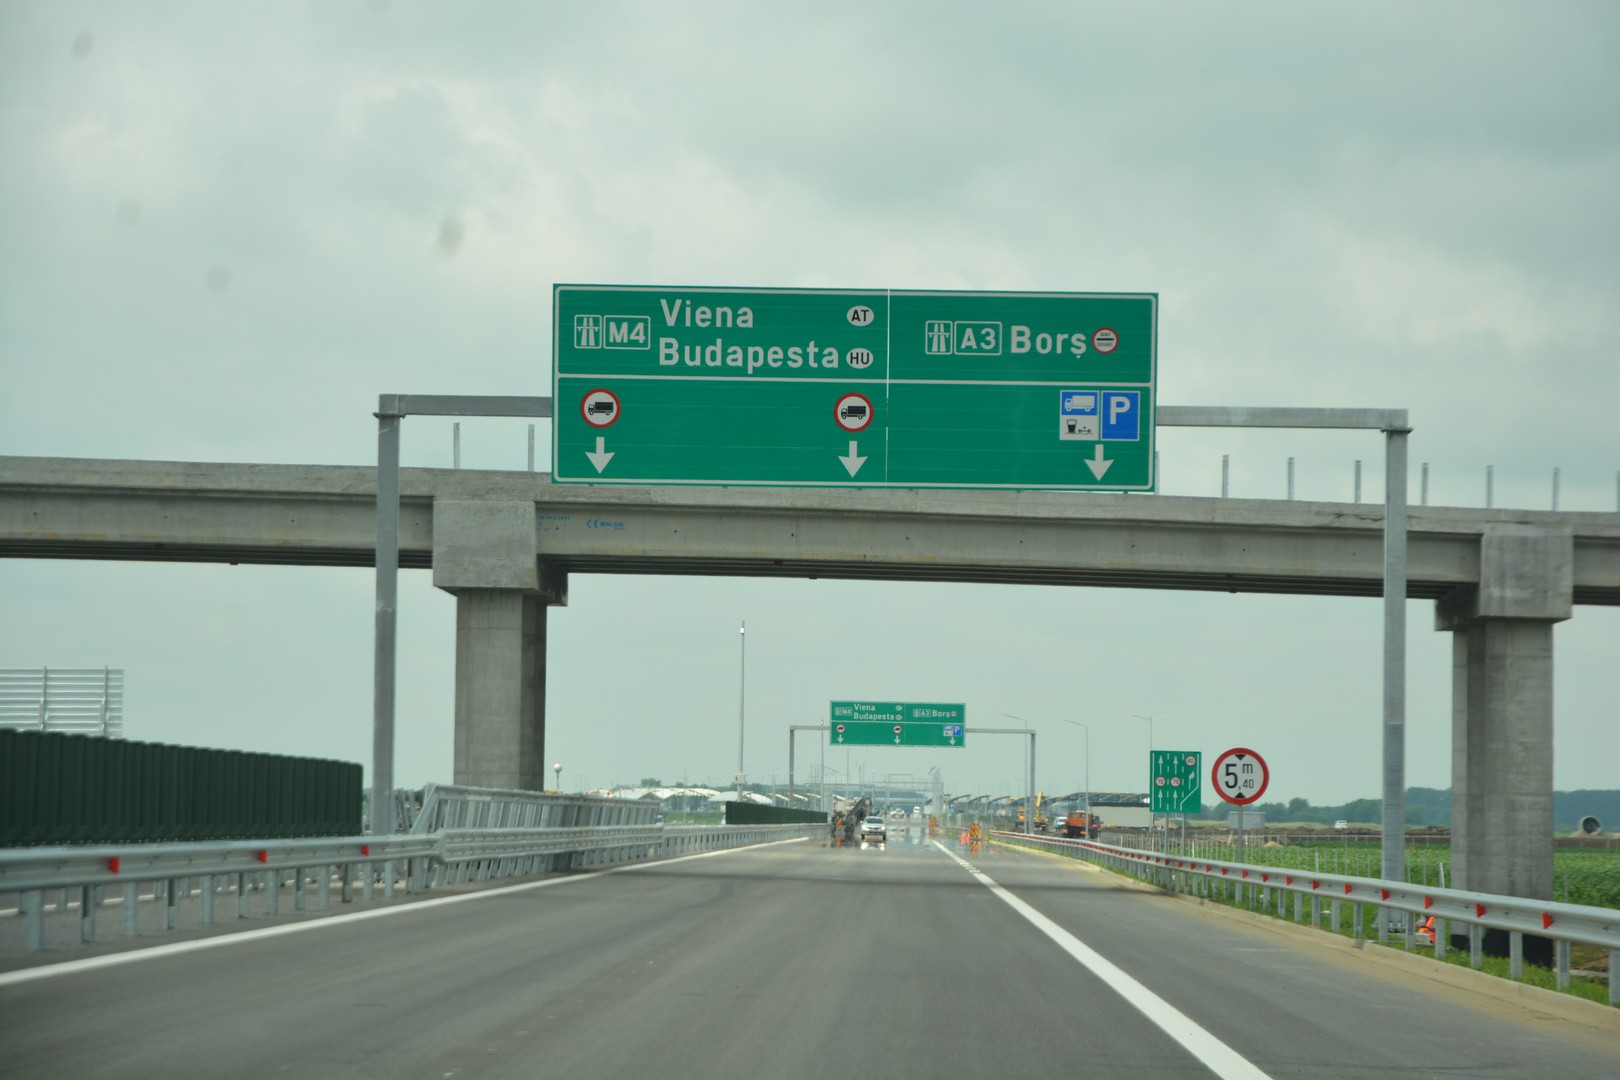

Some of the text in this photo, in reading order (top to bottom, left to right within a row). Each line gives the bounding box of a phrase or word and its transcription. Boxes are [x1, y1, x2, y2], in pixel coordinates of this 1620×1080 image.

[660, 299, 754, 329] Viena
[850, 309, 870, 322] AT
[609, 321, 646, 344] M4
[960, 327, 996, 350] A3
[1010, 325, 1087, 359] Borș
[659, 337, 839, 375] Budapesta
[849, 352, 870, 365] HU
[1109, 396, 1131, 425] P
[853, 712, 895, 721] Budapesta
[955, 726, 960, 734] P
